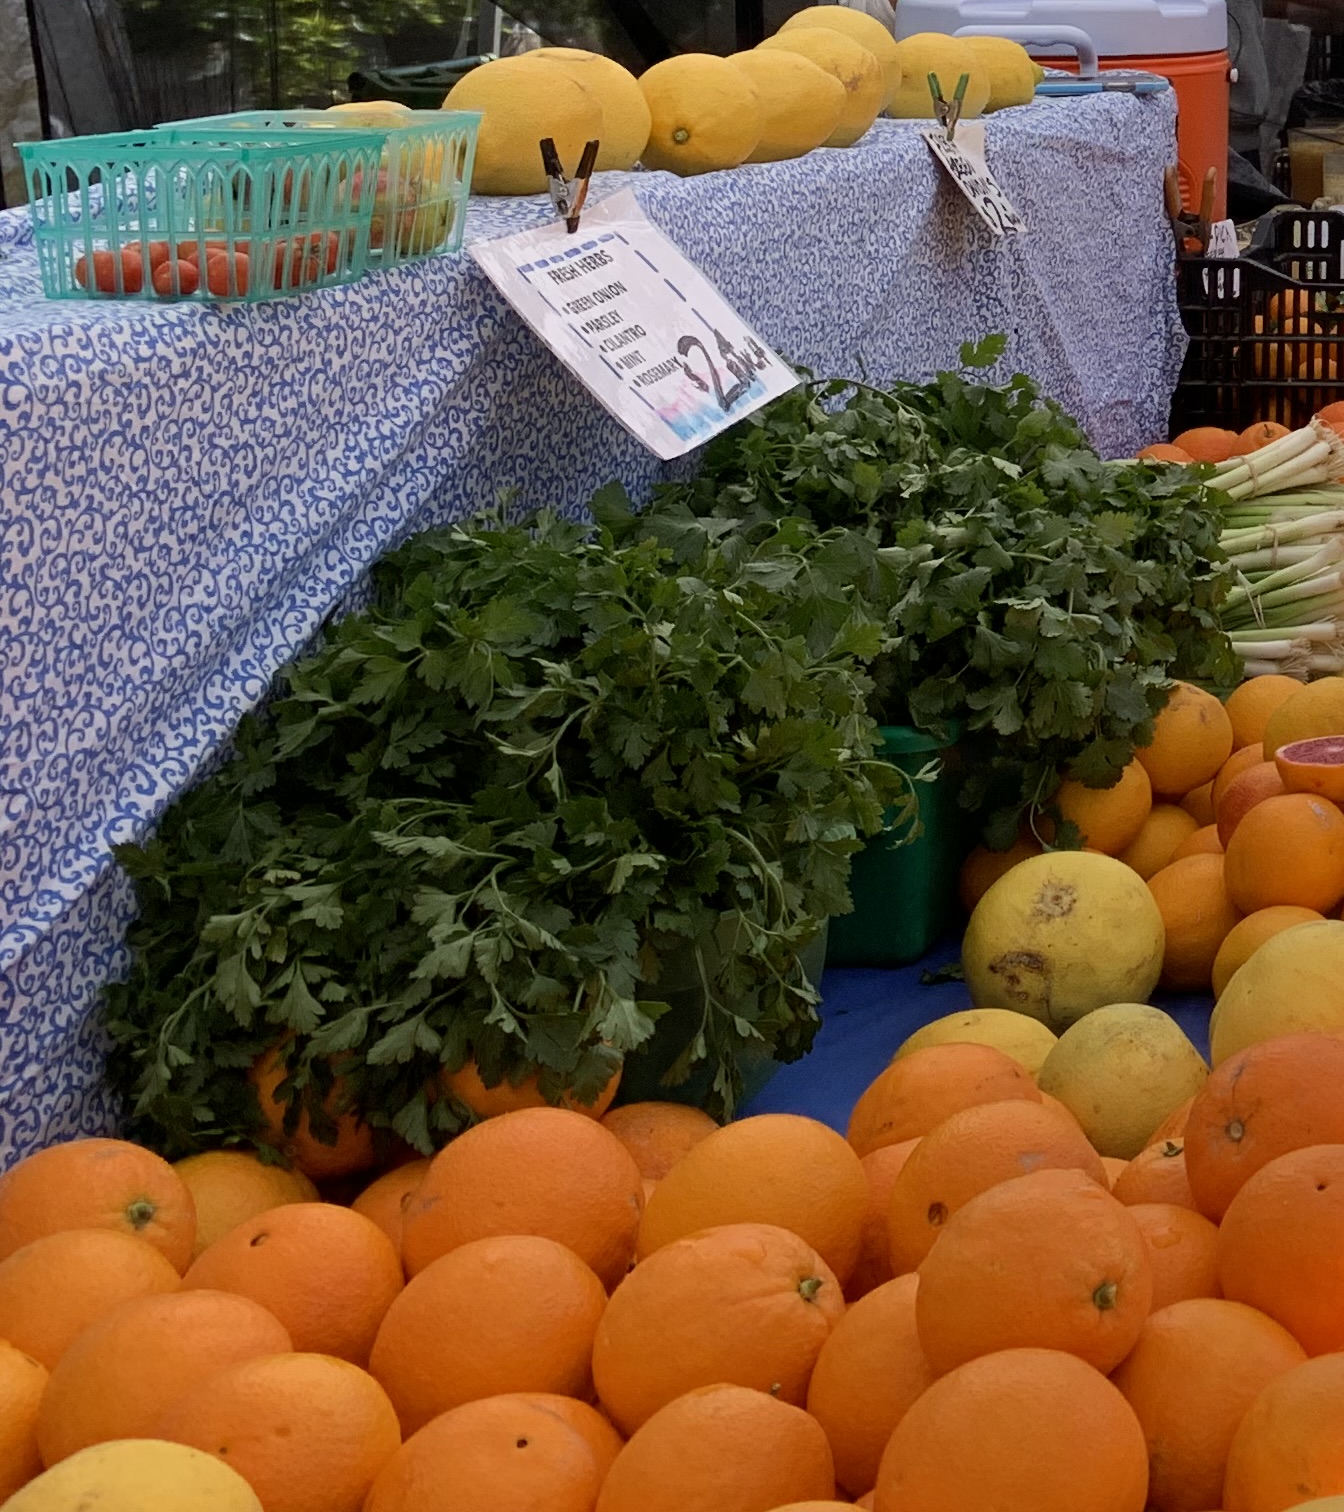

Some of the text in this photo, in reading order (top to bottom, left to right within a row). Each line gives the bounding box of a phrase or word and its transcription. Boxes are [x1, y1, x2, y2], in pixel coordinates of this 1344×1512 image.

[547, 249, 615, 286] FRESH HERBS
[566, 280, 628, 315] GREEN ONION
[585, 309, 625, 334] PARSLEY
[602, 324, 647, 352] CILANTRO
[618, 349, 647, 370] MINT
[636, 355, 684, 388] ROSEMARY
